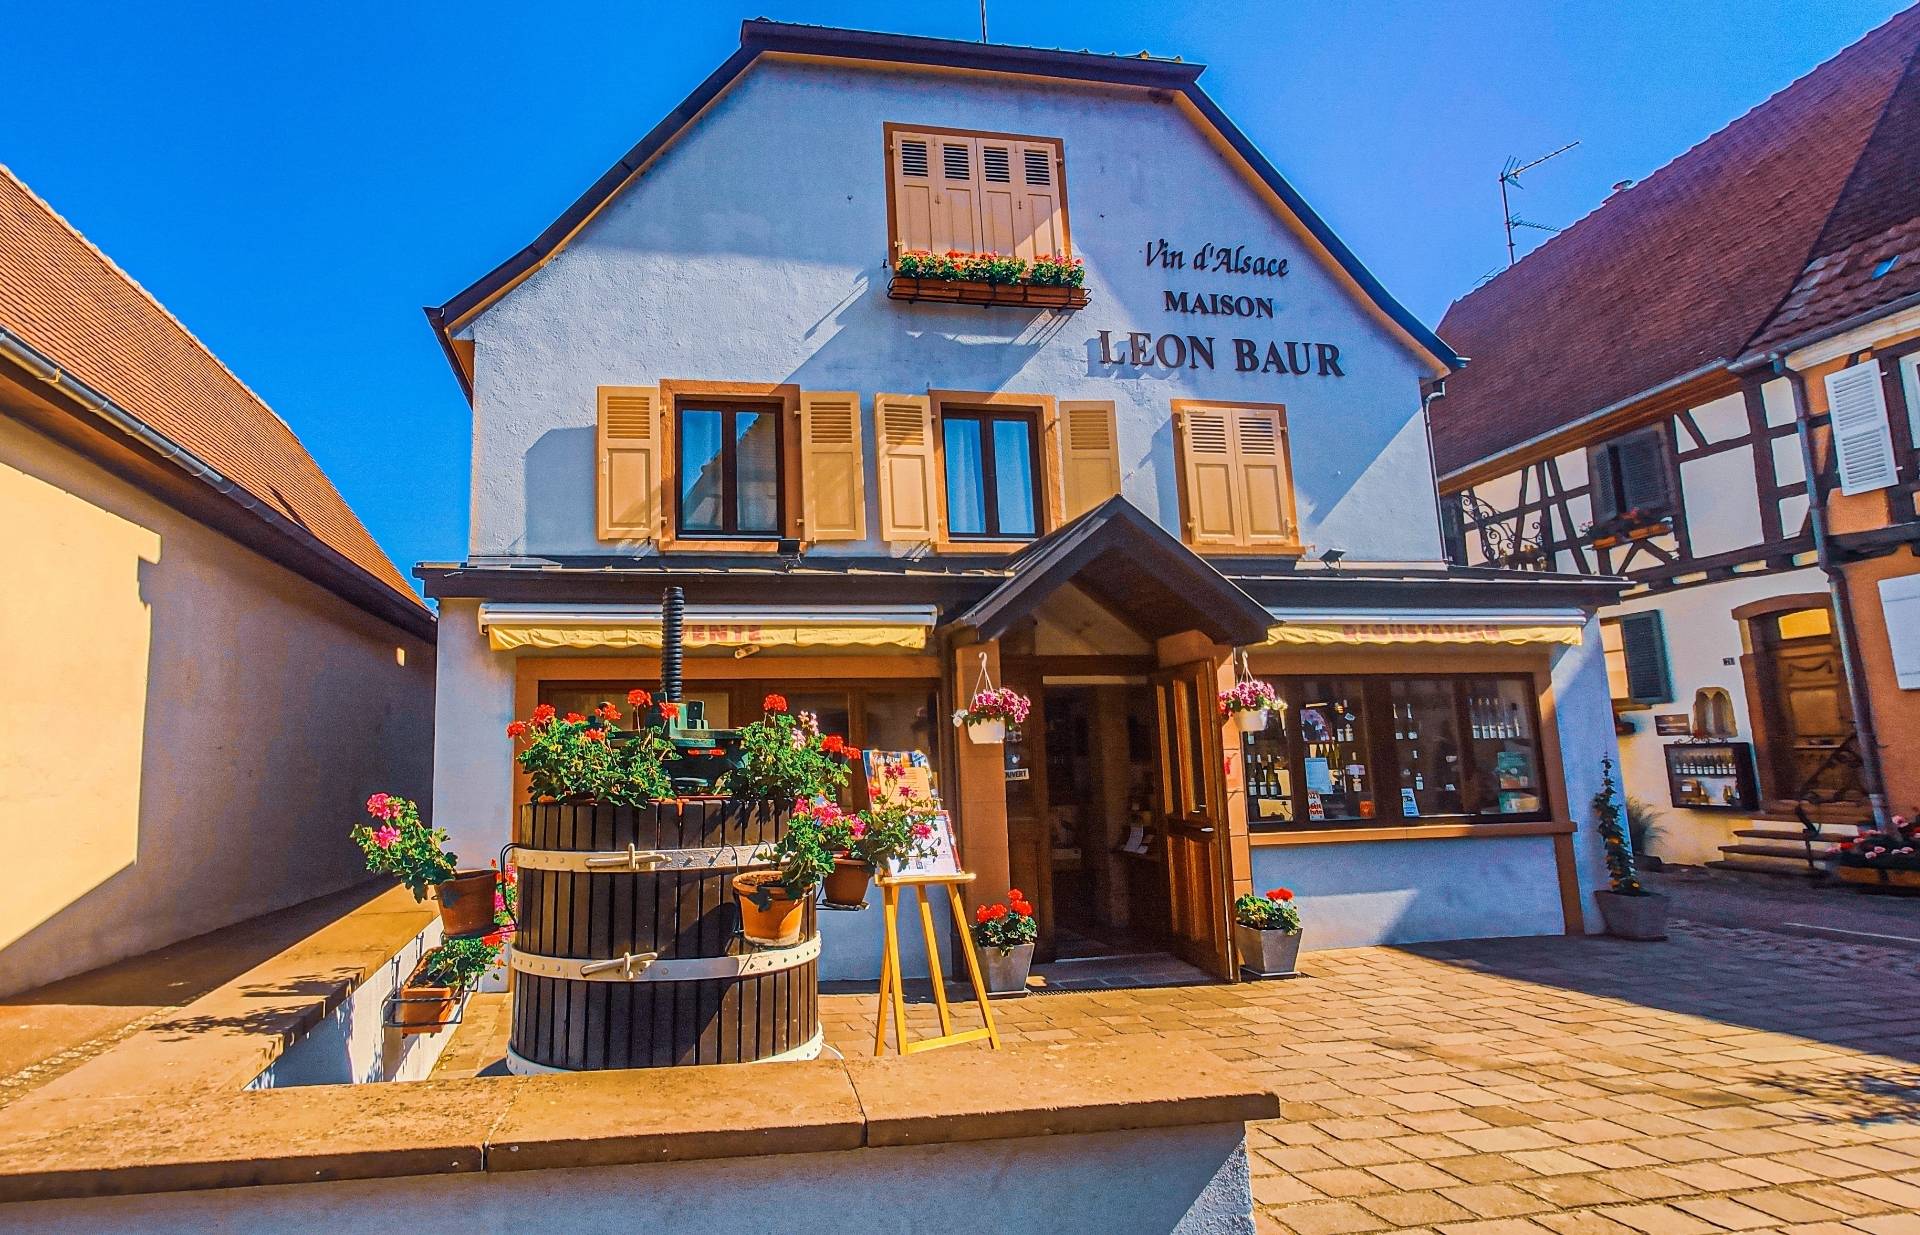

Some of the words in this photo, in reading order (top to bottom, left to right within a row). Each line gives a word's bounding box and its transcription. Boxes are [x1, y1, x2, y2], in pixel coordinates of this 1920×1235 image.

[1145, 238, 1184, 271] Vin
[1193, 242, 1290, 278] d'Alsace
[1163, 290, 1274, 319] MAISON
[1097, 329, 1216, 370] LEON
[1231, 338, 1346, 377] BAUR
